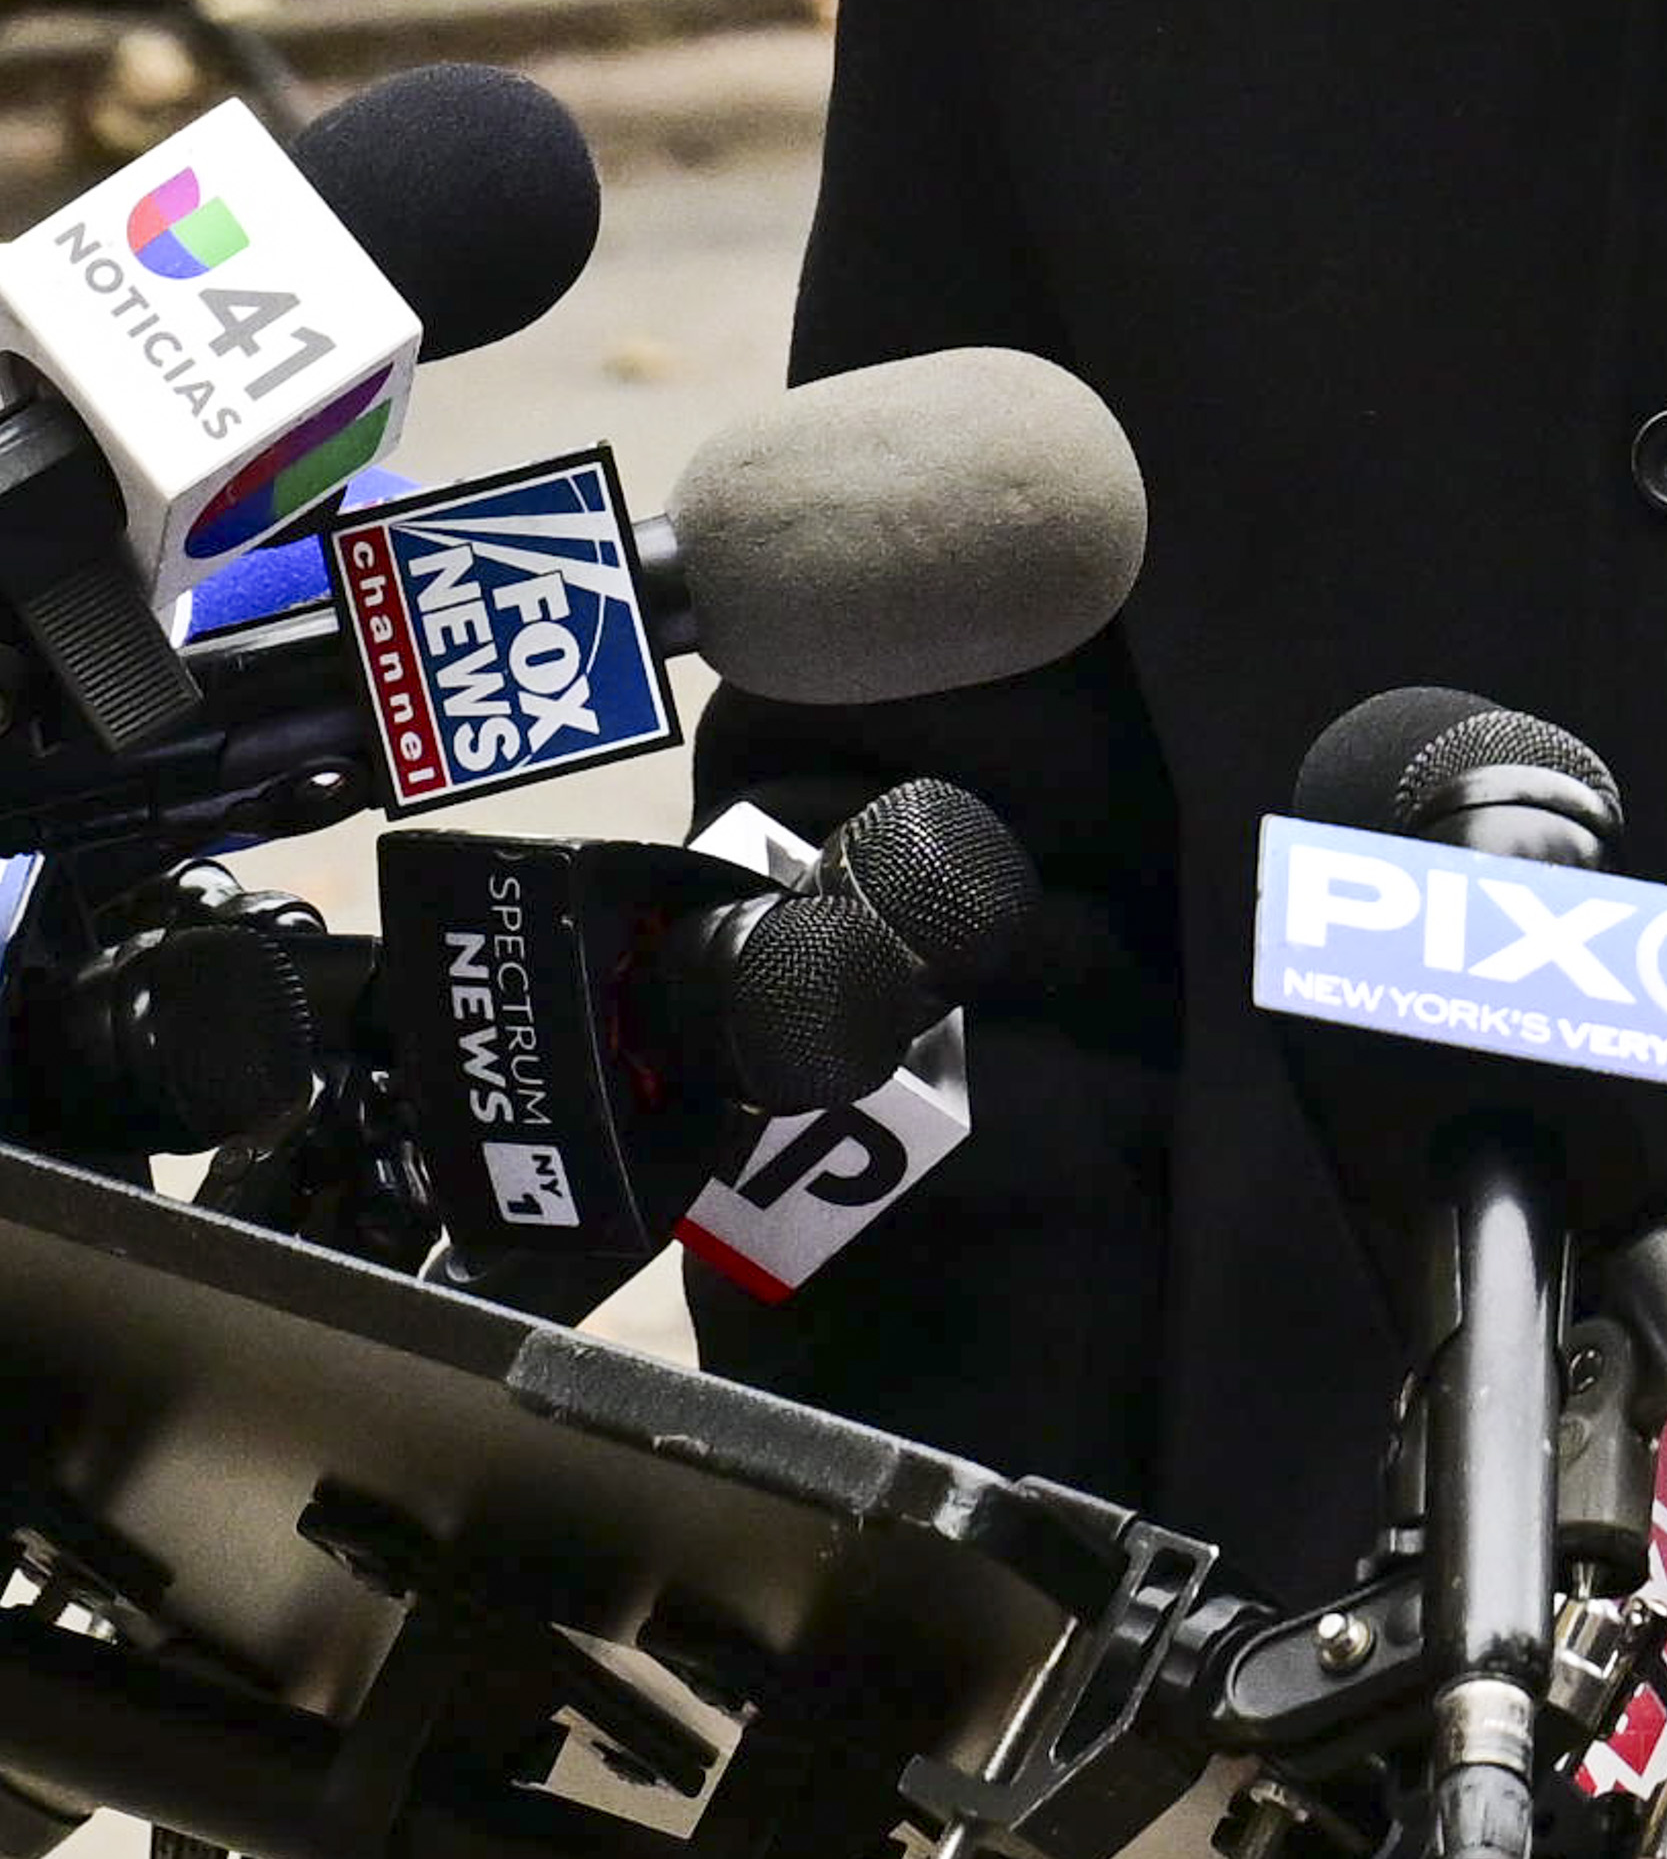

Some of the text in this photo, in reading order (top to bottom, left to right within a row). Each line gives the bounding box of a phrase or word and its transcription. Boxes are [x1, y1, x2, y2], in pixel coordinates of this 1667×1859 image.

[54, 222, 242, 440] NOTICIAS
[199, 288, 336, 402] 41
[352, 540, 434, 799] channel
[407, 543, 519, 773] NEWS
[492, 571, 602, 754] FOX
[488, 877, 553, 1126] SPECTRUM
[1283, 967, 1384, 1012] NEW
[1389, 986, 1552, 1044] YORK'S
[1286, 844, 1638, 1004] PIX
[444, 932, 514, 1125] NEWS
[505, 1192, 542, 1217] 1
[531, 1153, 562, 1196] NY
[712, 1103, 908, 1209] P
